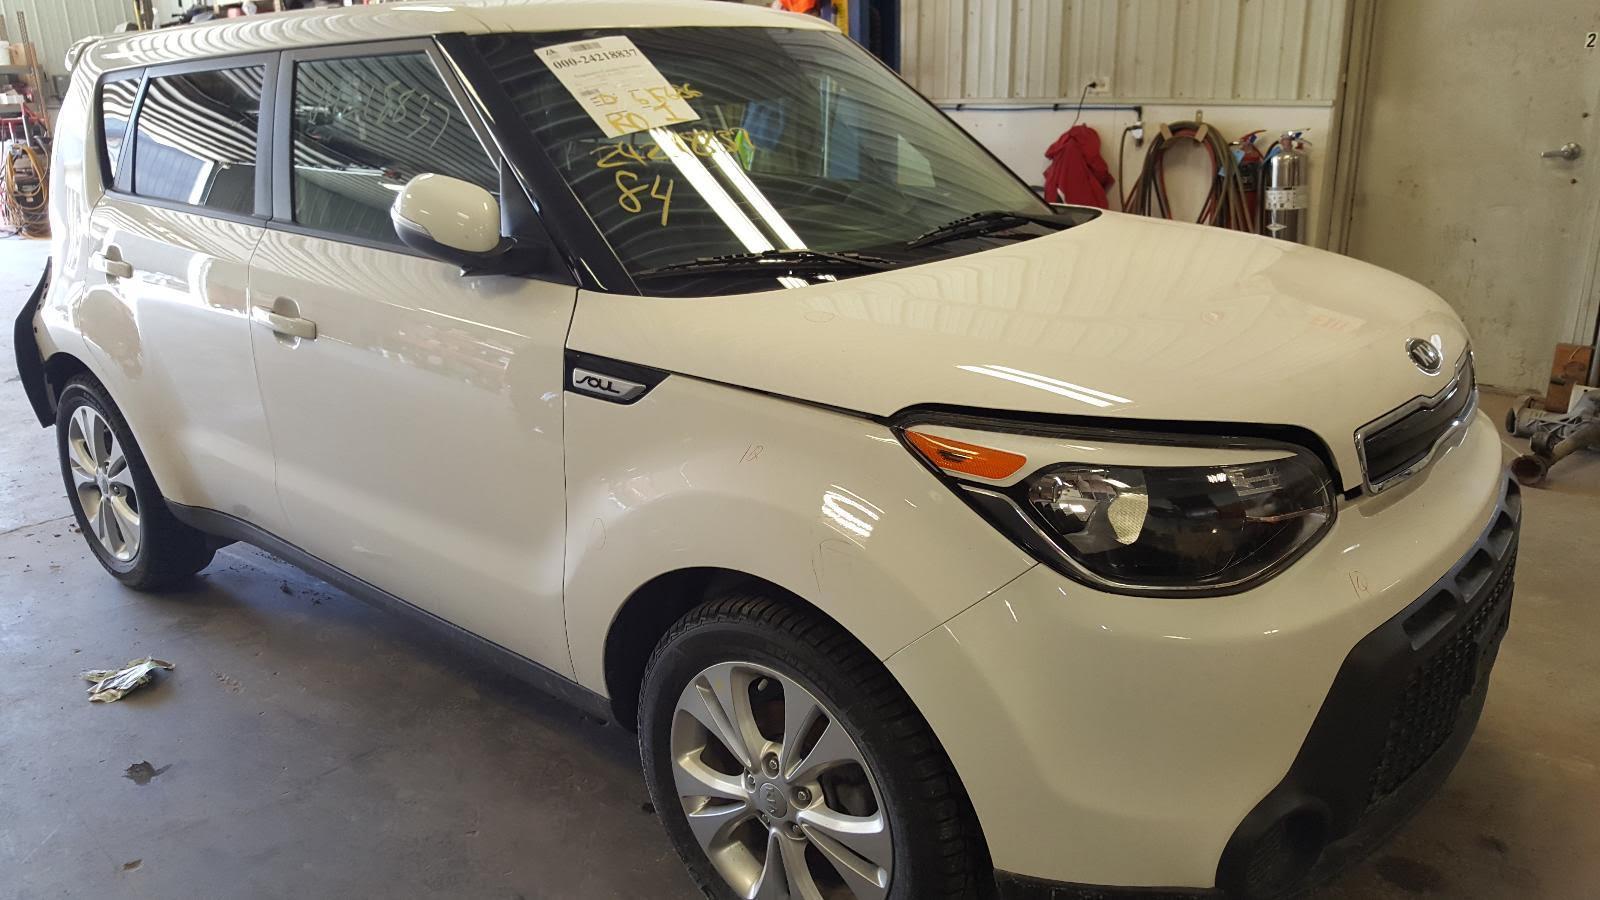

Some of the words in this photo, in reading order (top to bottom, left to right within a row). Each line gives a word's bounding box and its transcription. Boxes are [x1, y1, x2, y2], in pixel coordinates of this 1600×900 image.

[1586, 32, 1597, 48] 2
[552, 48, 638, 70] 000-24218837
[615, 169, 674, 227] 84
[576, 375, 621, 394] SOUL
